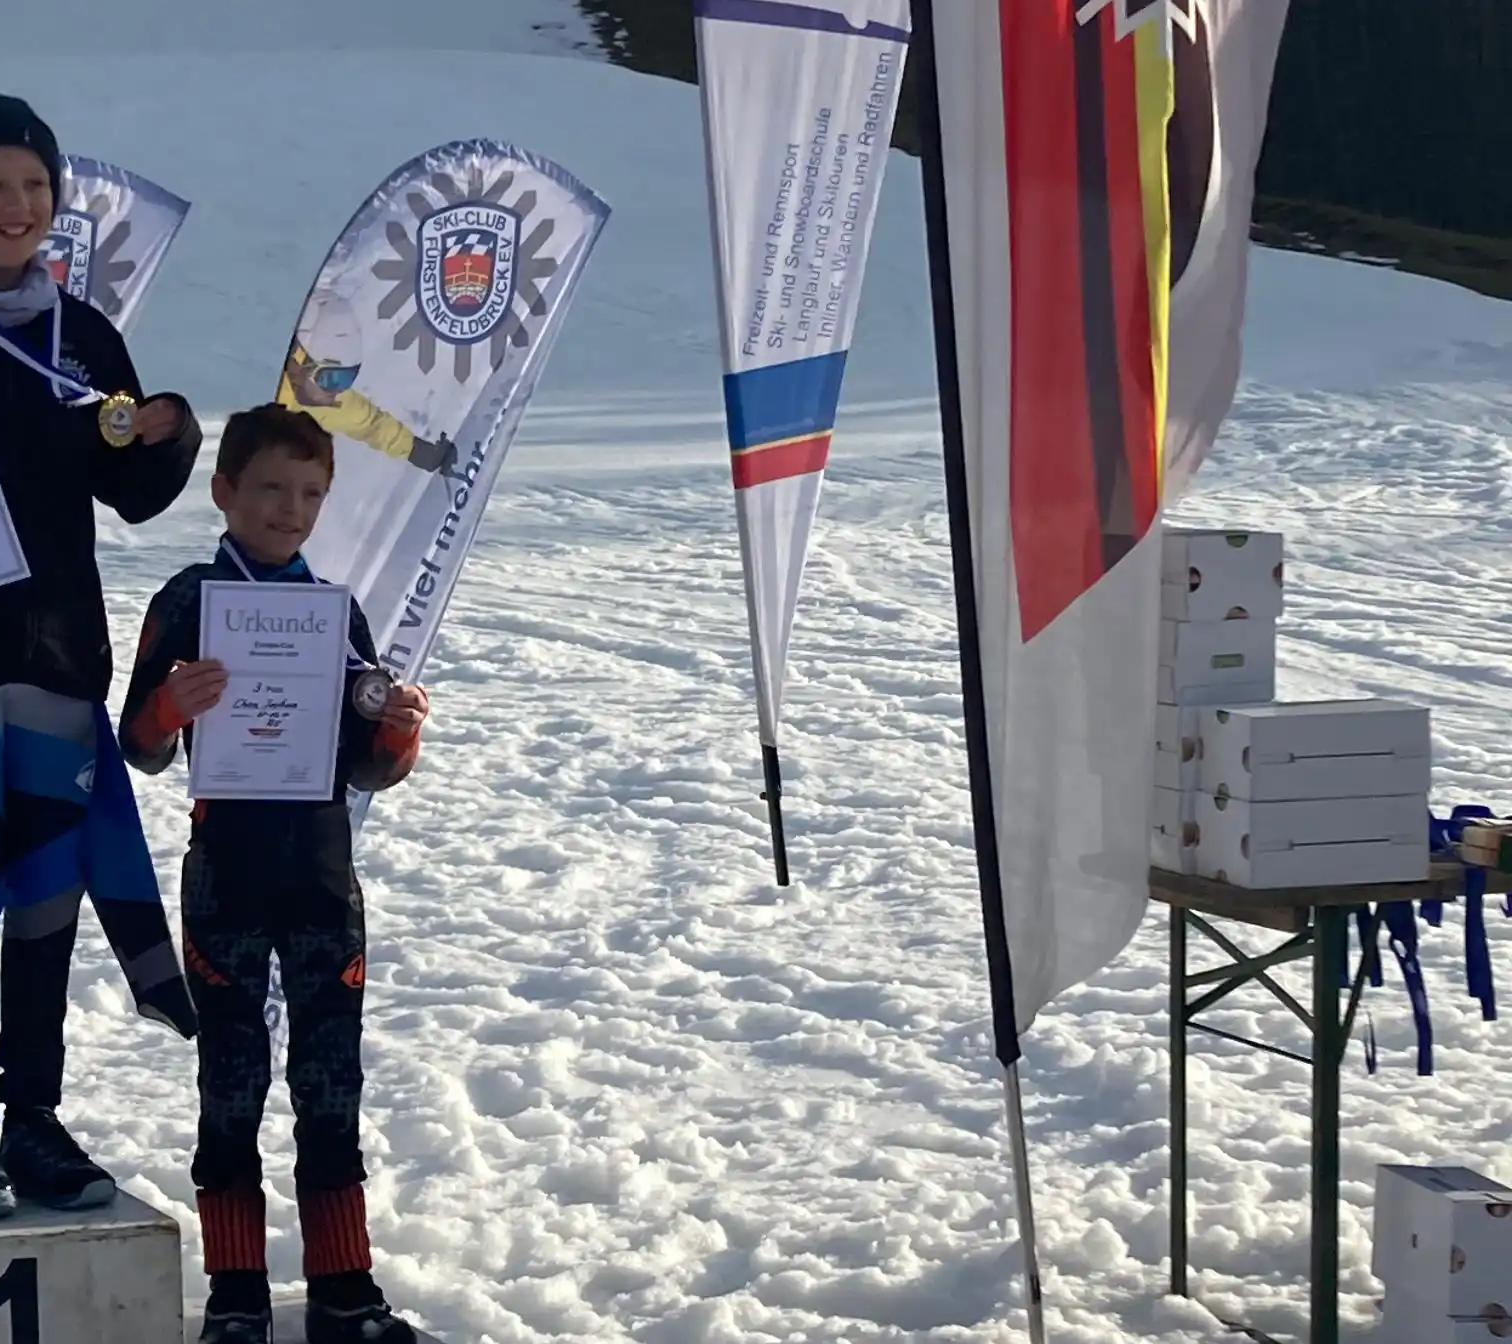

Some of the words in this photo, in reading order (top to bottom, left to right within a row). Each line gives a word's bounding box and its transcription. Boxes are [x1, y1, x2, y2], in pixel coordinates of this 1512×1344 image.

[856, 51, 894, 150] Radfahren
[767, 142, 801, 237] Rennsport
[784, 106, 833, 271] Snowboardschule
[816, 132, 851, 218] Skitouren
[852, 150, 871, 187] und
[433, 210, 508, 232] SKI-CLUB
[814, 223, 832, 260] und
[835, 191, 862, 272] Wandern
[762, 241, 779, 277] und
[780, 273, 797, 310] und
[743, 281, 770, 357] Freizeit-
[766, 310, 787, 350] Ski-
[792, 264, 822, 344] Langlauf
[224, 609, 329, 634] Urkunde
[398, 557, 442, 629] viel
